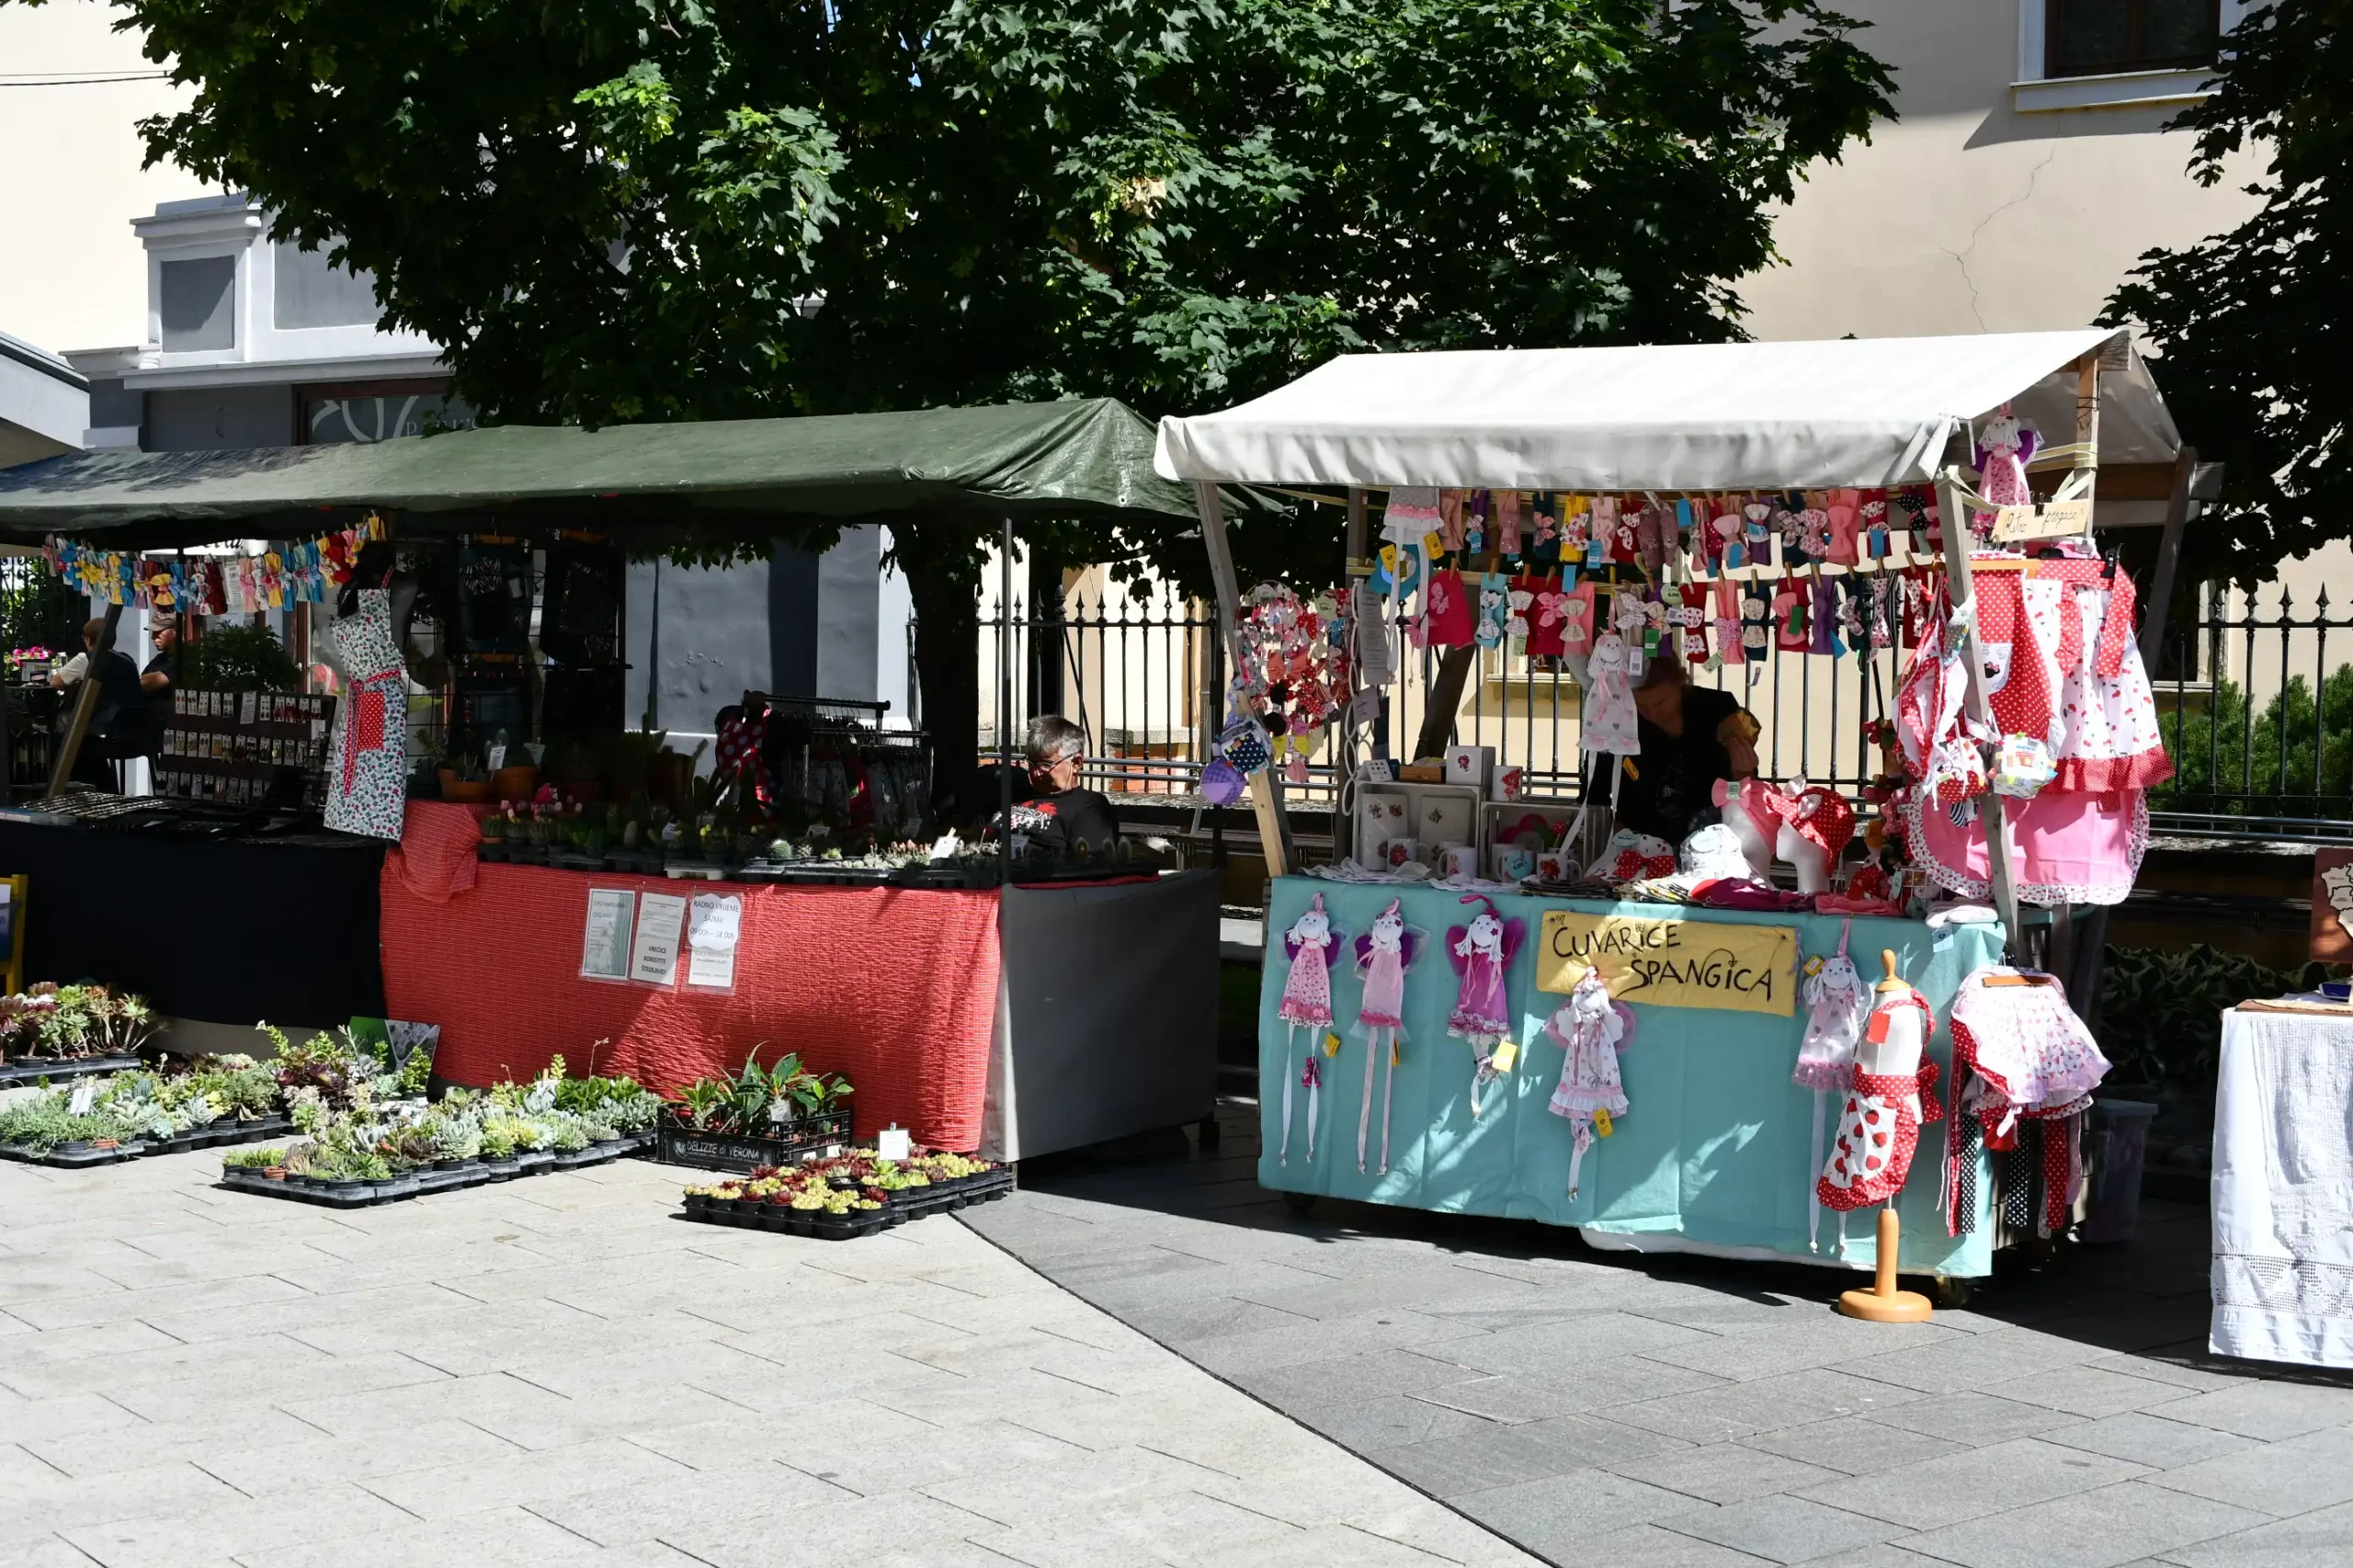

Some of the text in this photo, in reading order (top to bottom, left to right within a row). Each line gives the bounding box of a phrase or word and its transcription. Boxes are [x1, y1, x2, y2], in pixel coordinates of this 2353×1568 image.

[693, 900, 740, 913] RADNO VRIJEME
[687, 1140, 718, 1154] DELIZIE
[720, 1145, 727, 1154] di
[729, 1145, 760, 1160] VERONA
